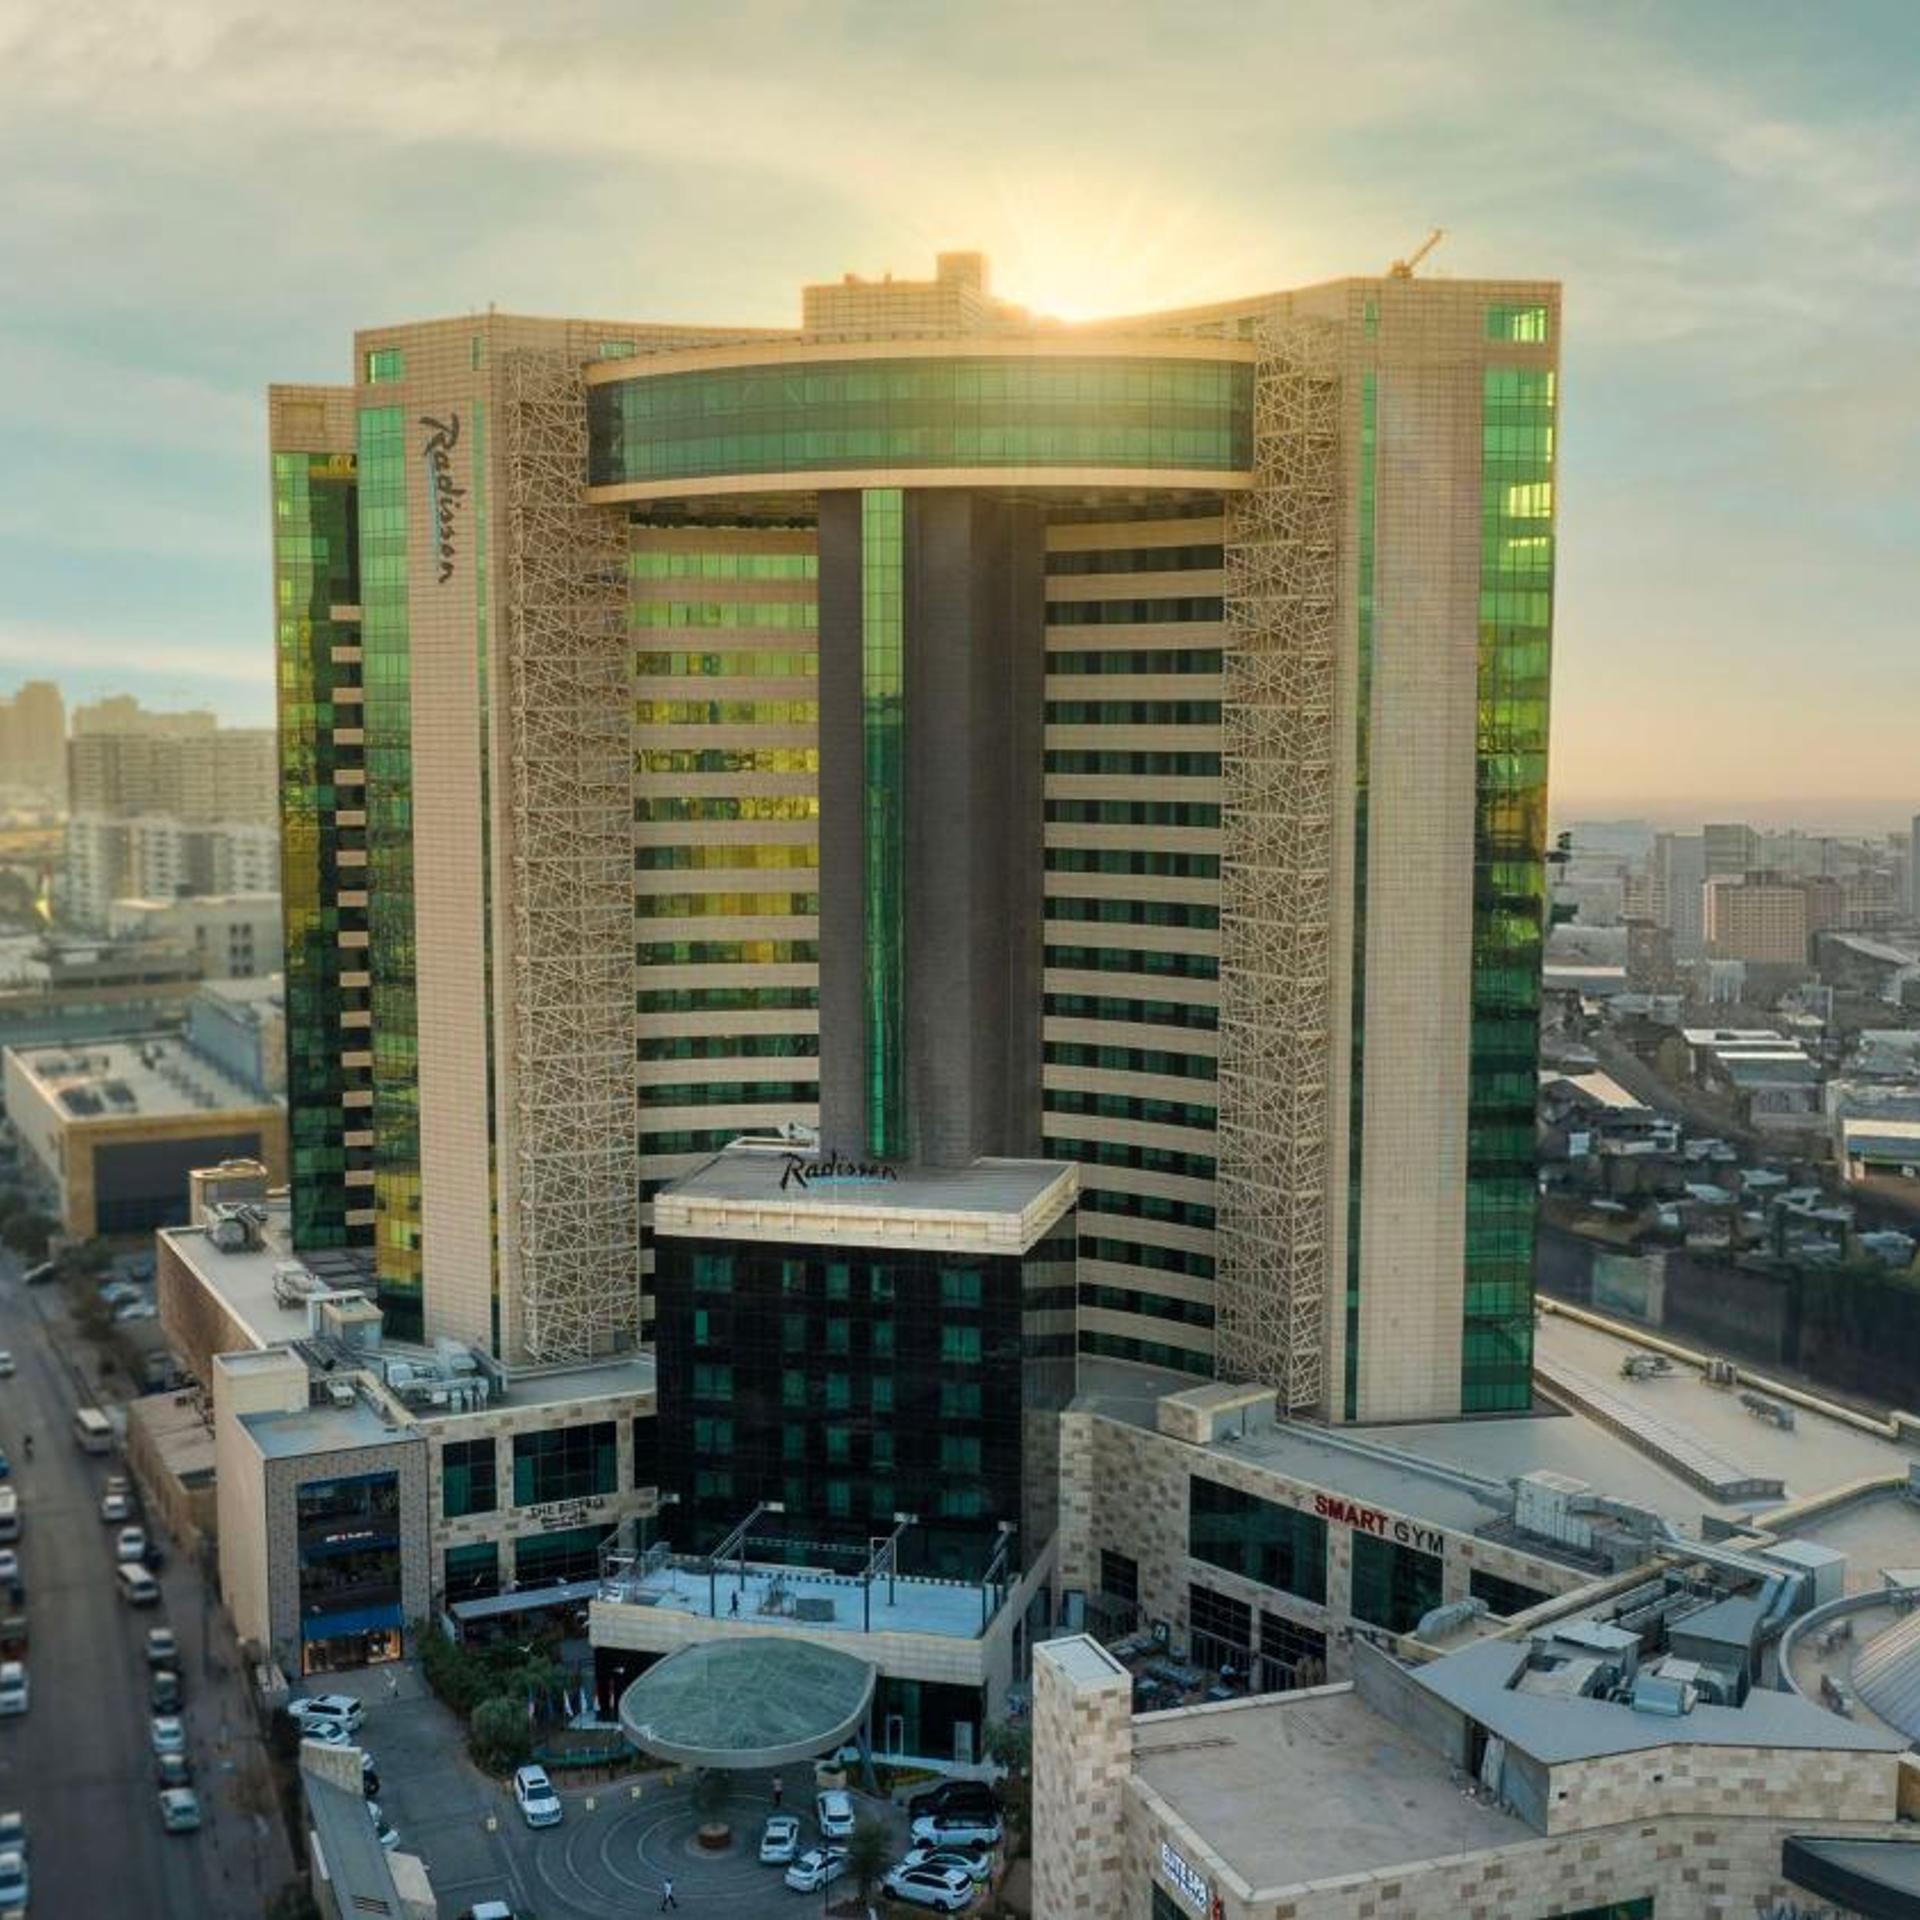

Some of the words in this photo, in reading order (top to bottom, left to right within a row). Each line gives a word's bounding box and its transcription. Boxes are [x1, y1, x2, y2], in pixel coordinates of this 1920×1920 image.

[419, 413, 466, 583] Radisson
[778, 1149, 897, 1191] Radisson
[1315, 1494, 1388, 1536] SMART
[1394, 1520, 1444, 1554] GYM
